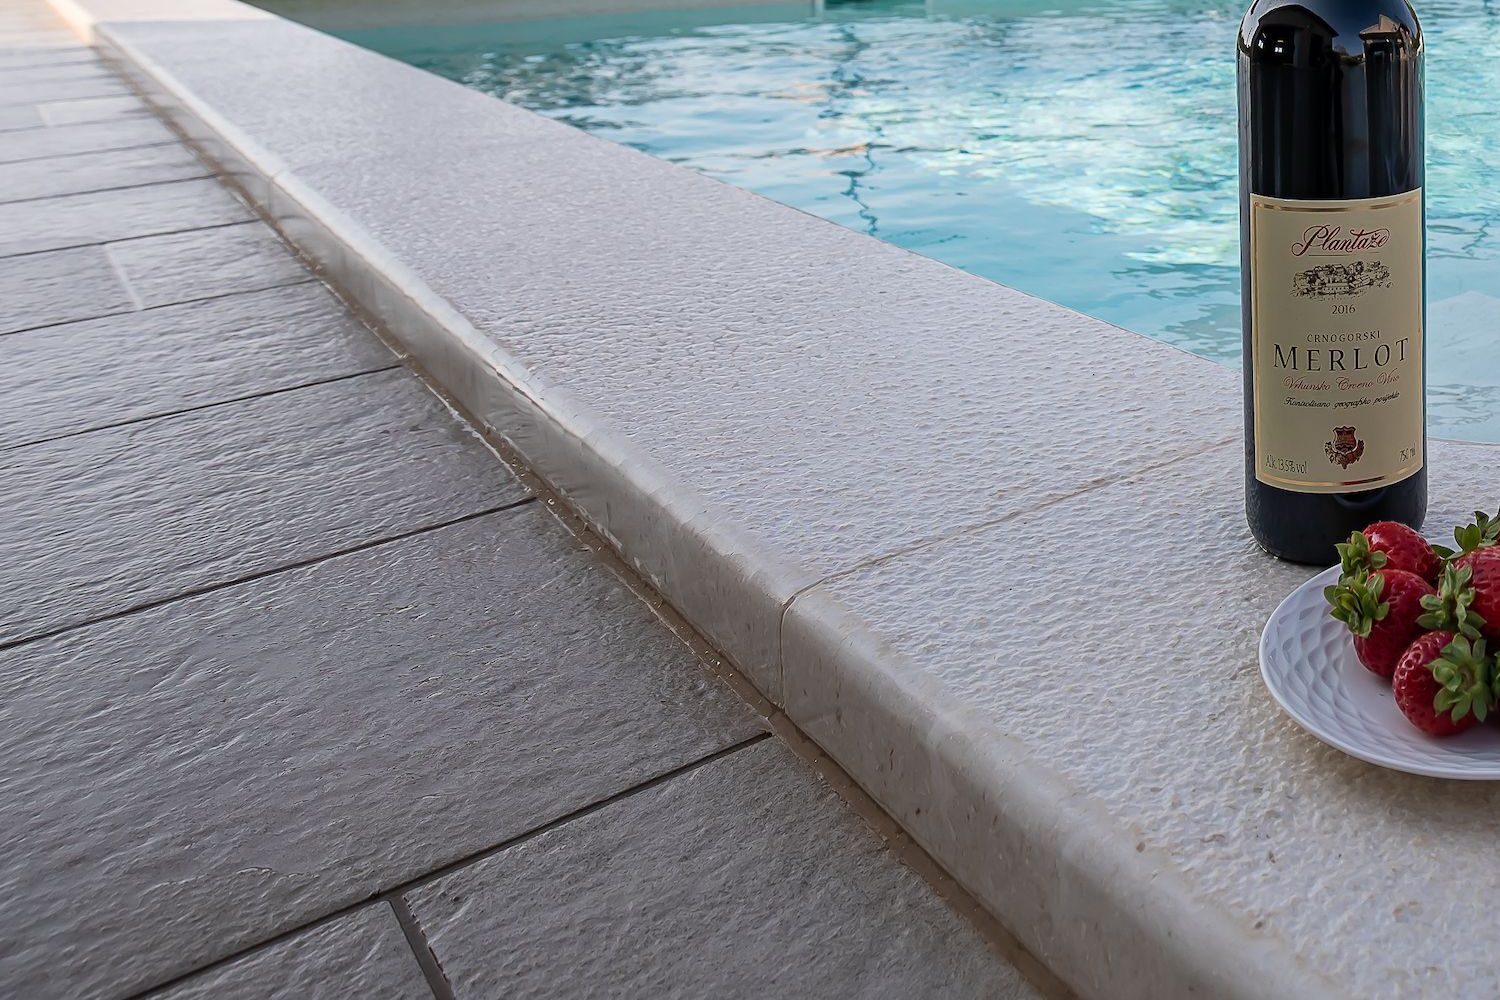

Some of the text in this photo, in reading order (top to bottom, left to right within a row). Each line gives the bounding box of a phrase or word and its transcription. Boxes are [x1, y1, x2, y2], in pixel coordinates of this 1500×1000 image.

[1291, 224, 1390, 257] Plantaže
[1332, 304, 1356, 315] 2016
[1307, 330, 1380, 343] CRNOGORSKI
[1273, 338, 1409, 371] MERLOT
